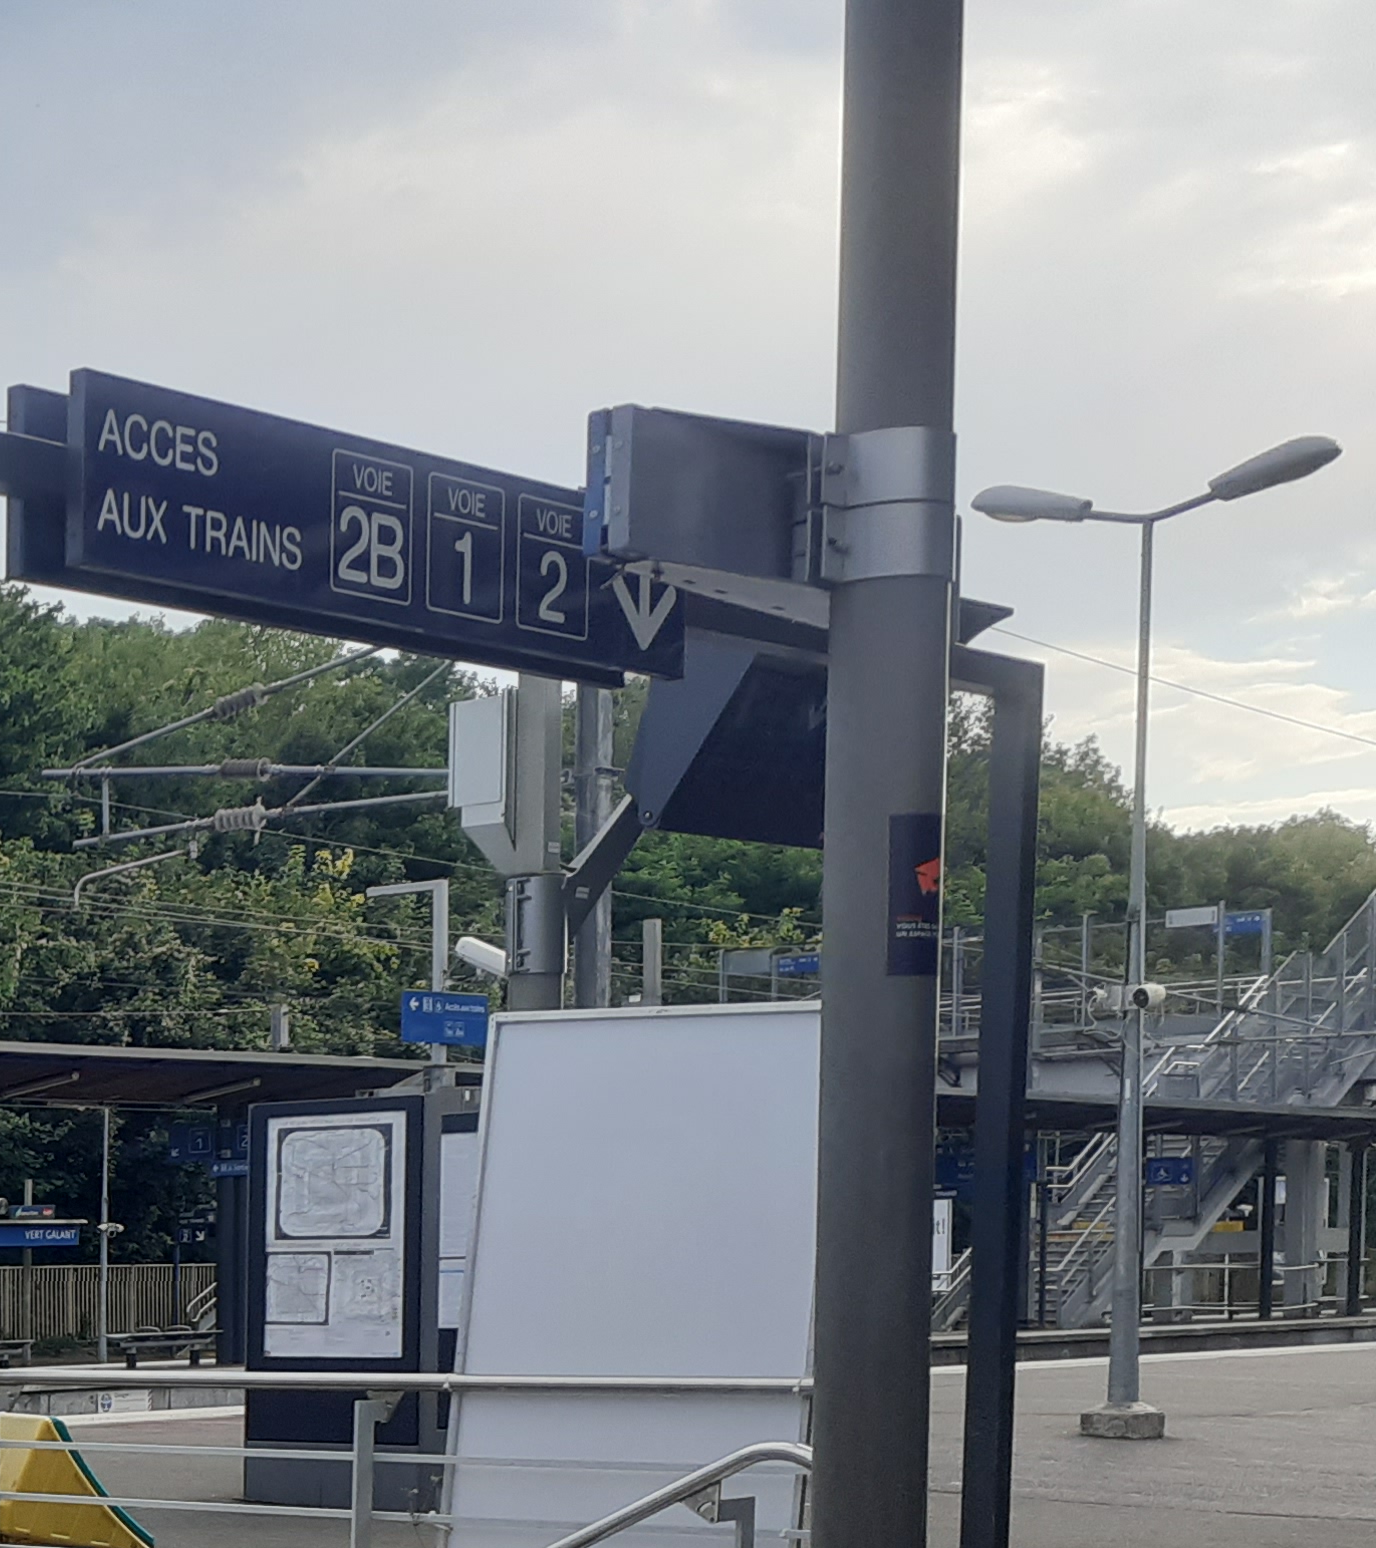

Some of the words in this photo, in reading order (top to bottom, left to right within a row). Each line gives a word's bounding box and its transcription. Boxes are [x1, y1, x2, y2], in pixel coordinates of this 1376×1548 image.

[99, 408, 218, 477] ACCES
[353, 463, 393, 497] VOIE
[448, 486, 486, 519] VOIE
[97, 487, 168, 545] AUX
[182, 504, 303, 571] TRAINS
[338, 505, 405, 590] 2B
[536, 508, 573, 539] VOIE
[454, 530, 472, 605] 1
[538, 550, 568, 624] 2
[24, 1229, 44, 1240] VERT
[45, 1230, 76, 1240] GALANT
